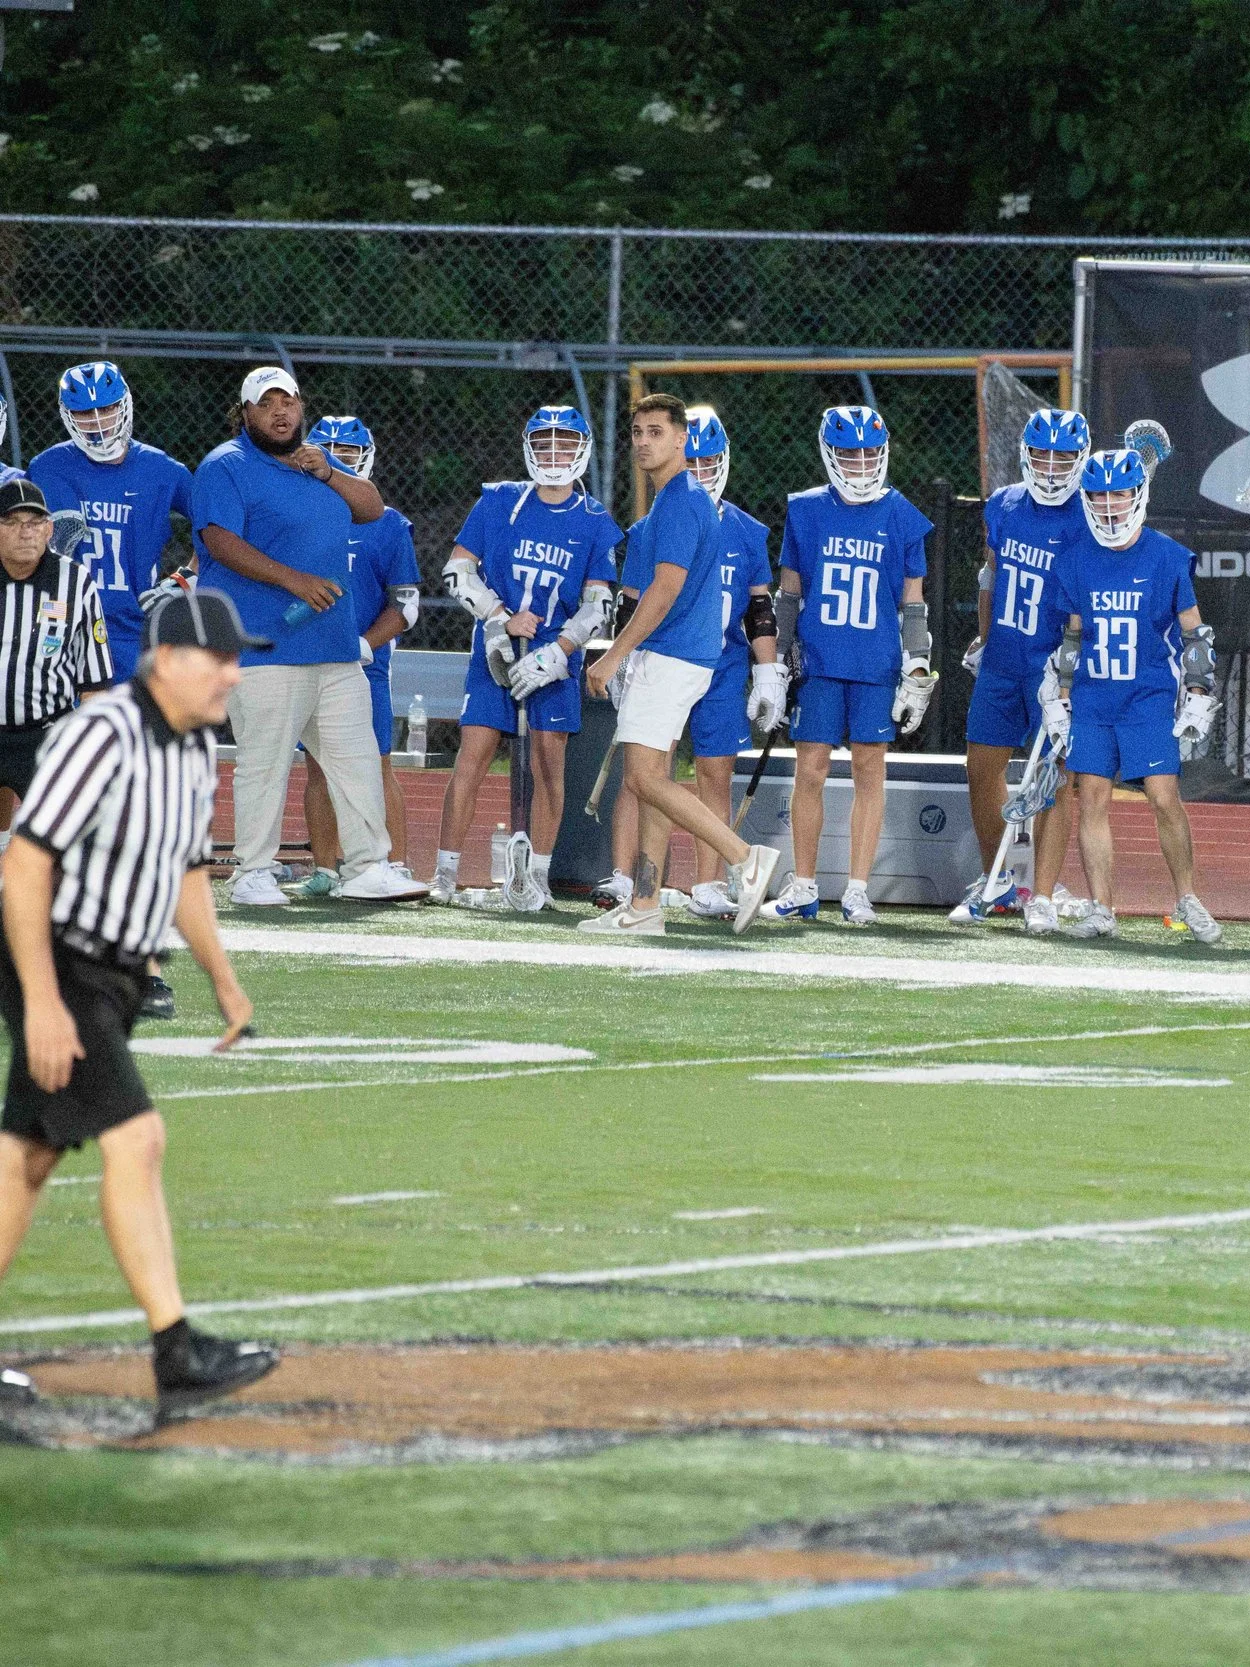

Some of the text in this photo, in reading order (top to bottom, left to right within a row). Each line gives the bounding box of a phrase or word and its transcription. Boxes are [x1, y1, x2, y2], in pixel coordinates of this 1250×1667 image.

[82, 527, 129, 591] 21
[513, 539, 574, 571] JESUIT
[822, 536, 885, 563] JESUIT
[1000, 538, 1055, 571] JESUIT
[512, 563, 565, 628] 77
[820, 562, 879, 630] 50
[997, 563, 1044, 636] 13
[1090, 591, 1143, 611] ESUIT
[1087, 617, 1138, 681] 33
